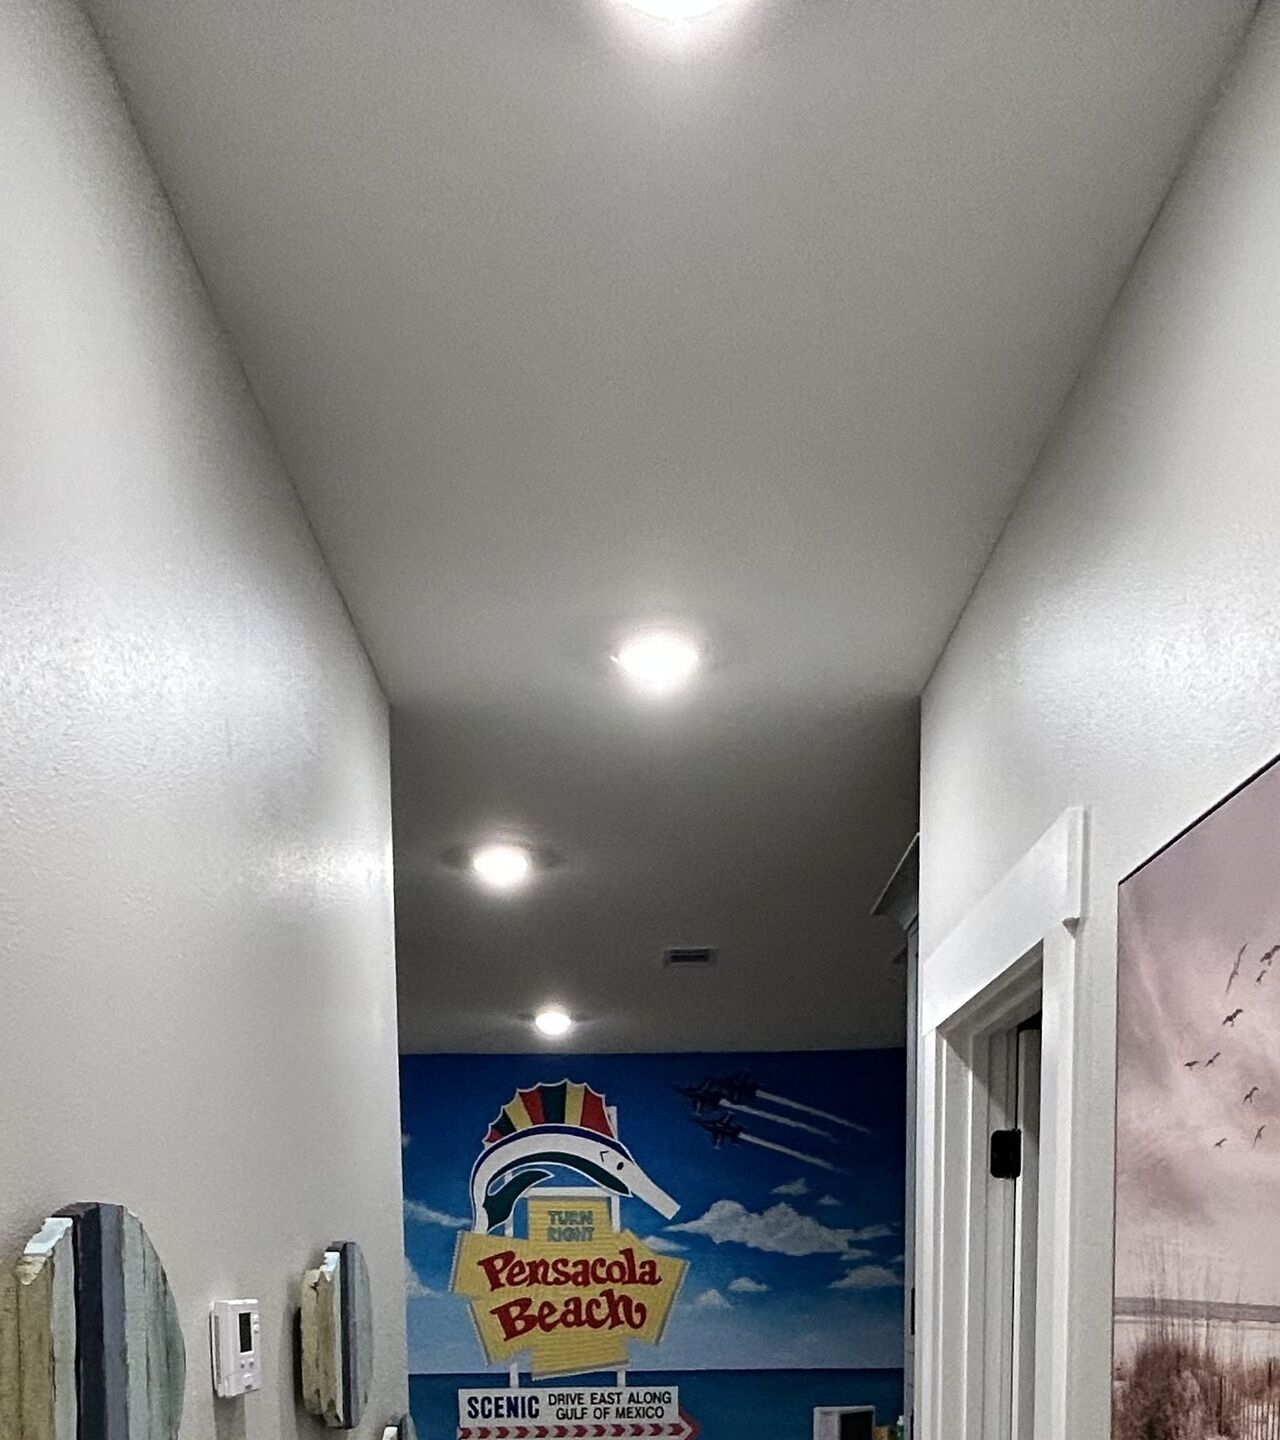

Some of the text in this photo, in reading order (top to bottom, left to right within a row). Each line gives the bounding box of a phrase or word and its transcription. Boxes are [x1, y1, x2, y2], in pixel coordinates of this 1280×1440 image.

[547, 1210, 594, 1226] TURN
[547, 1226, 594, 1242] RIGHT
[477, 1247, 662, 1291] Pensacola
[490, 1288, 647, 1341] Beach
[548, 1391, 672, 1405] DRIVE EAST ALONG
[467, 1395, 540, 1419] SCENIC
[556, 1405, 664, 1420] GULF OF MEXICO
